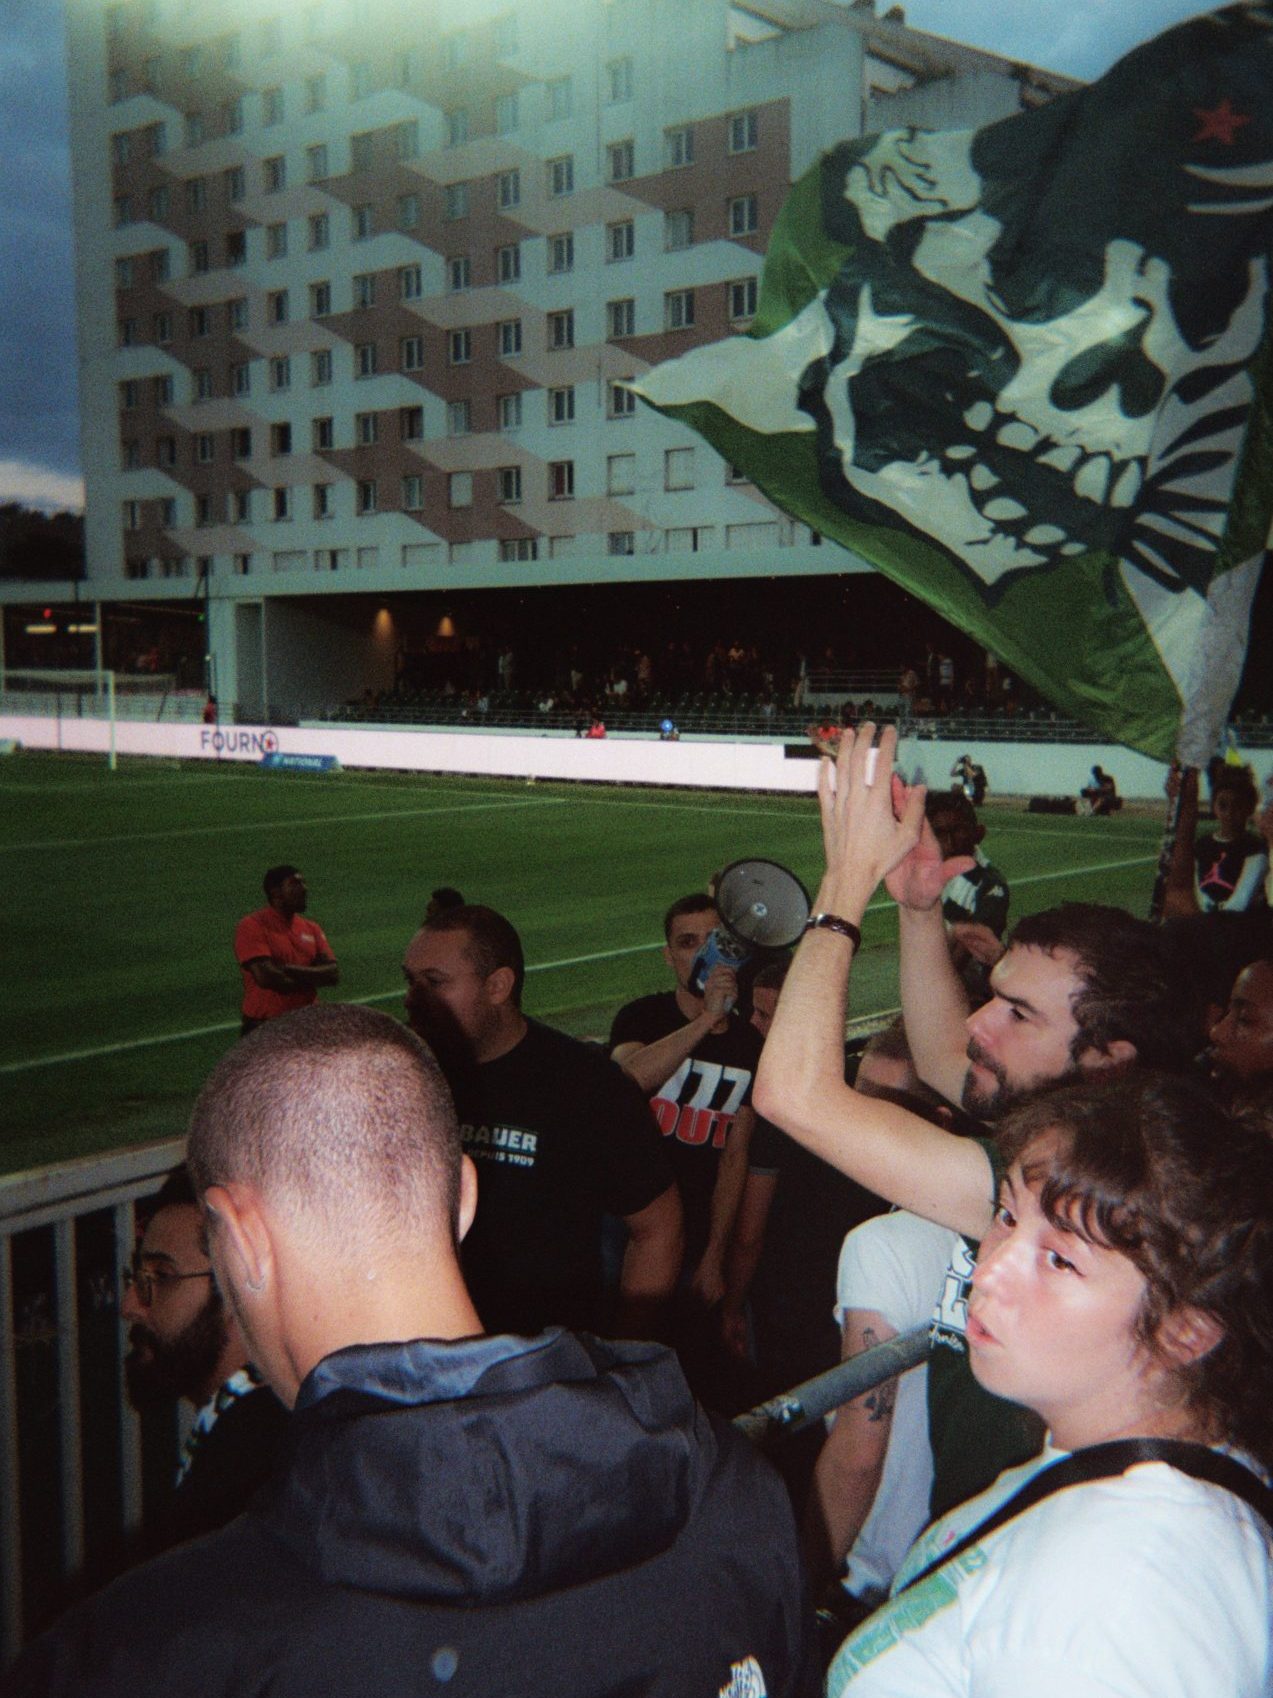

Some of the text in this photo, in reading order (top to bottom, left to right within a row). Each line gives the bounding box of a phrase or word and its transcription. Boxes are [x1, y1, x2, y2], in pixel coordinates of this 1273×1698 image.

[649, 1097, 735, 1148] OUT
[461, 1124, 537, 1151] BAUER
[508, 1153, 535, 1167] 1909
